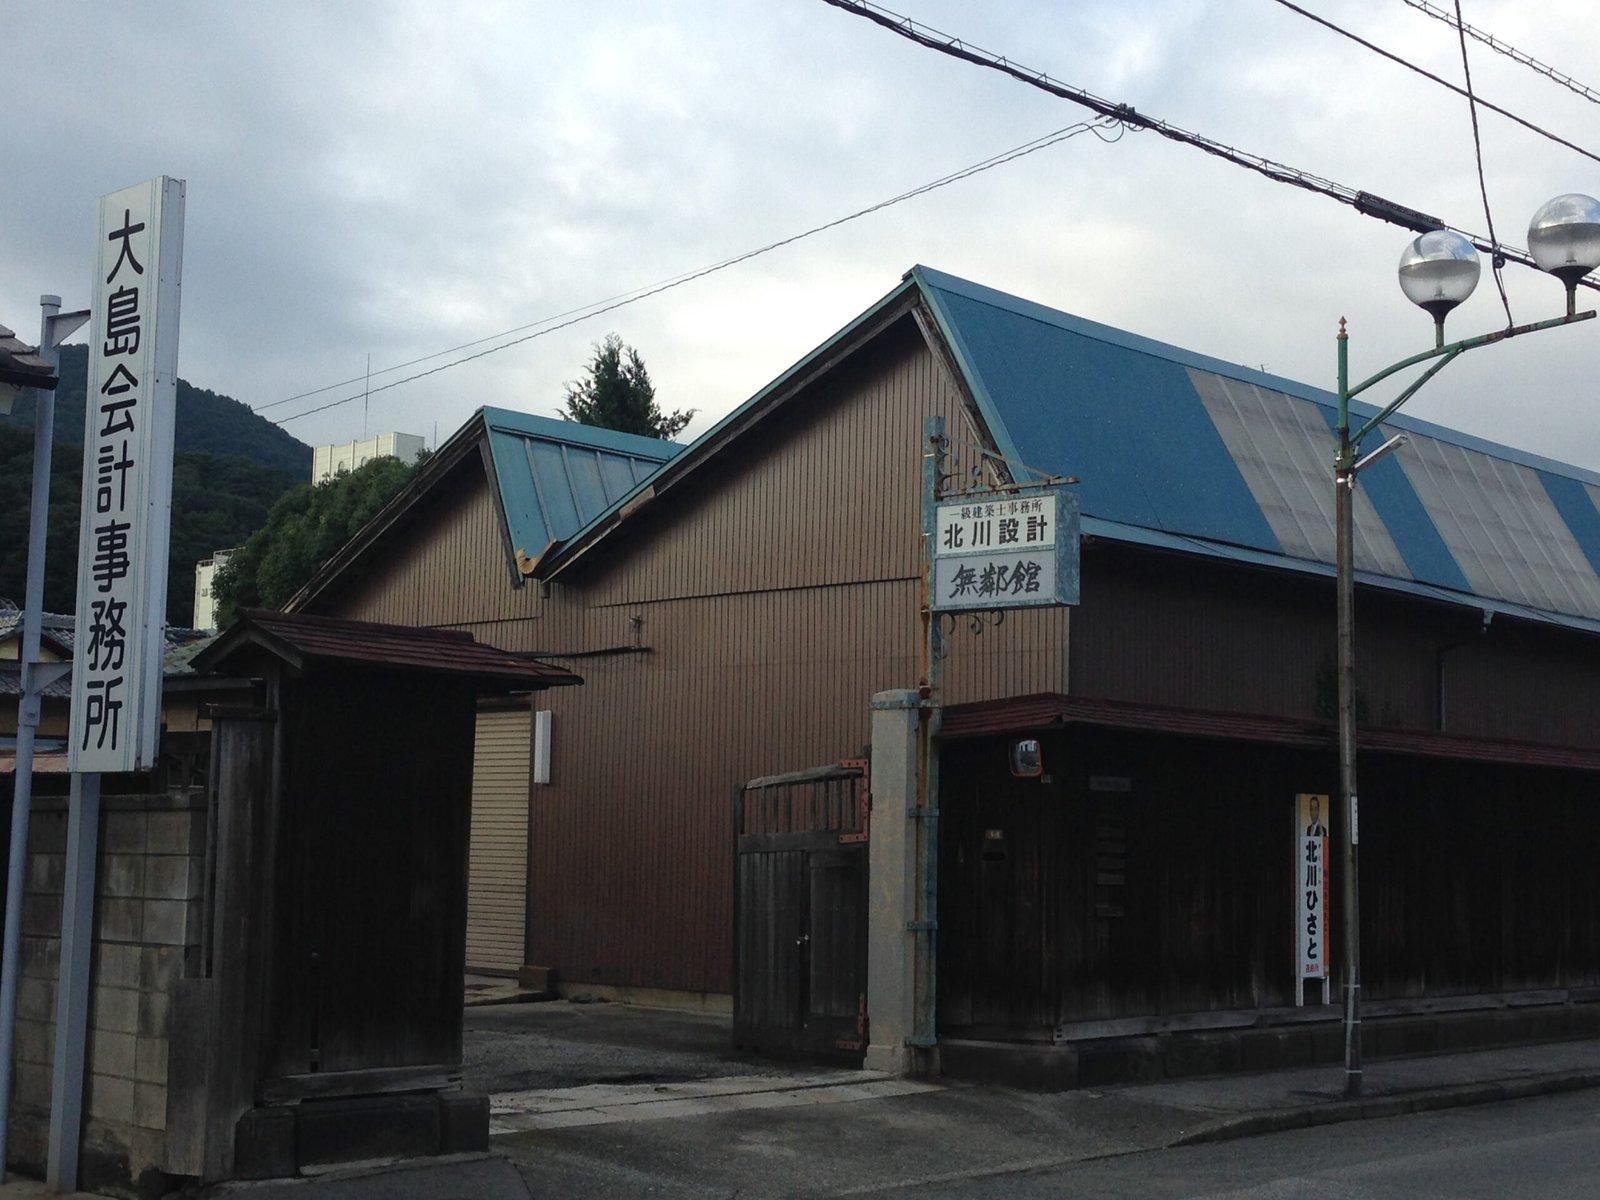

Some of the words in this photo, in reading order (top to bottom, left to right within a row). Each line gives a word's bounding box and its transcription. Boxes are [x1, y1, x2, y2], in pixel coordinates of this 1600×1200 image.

[82, 208, 146, 751] 大島会計事務所
[949, 499, 1042, 519] 一級建築士事務所
[944, 515, 1048, 549] 北川設計
[1305, 840, 1318, 960] 北川ひさと
